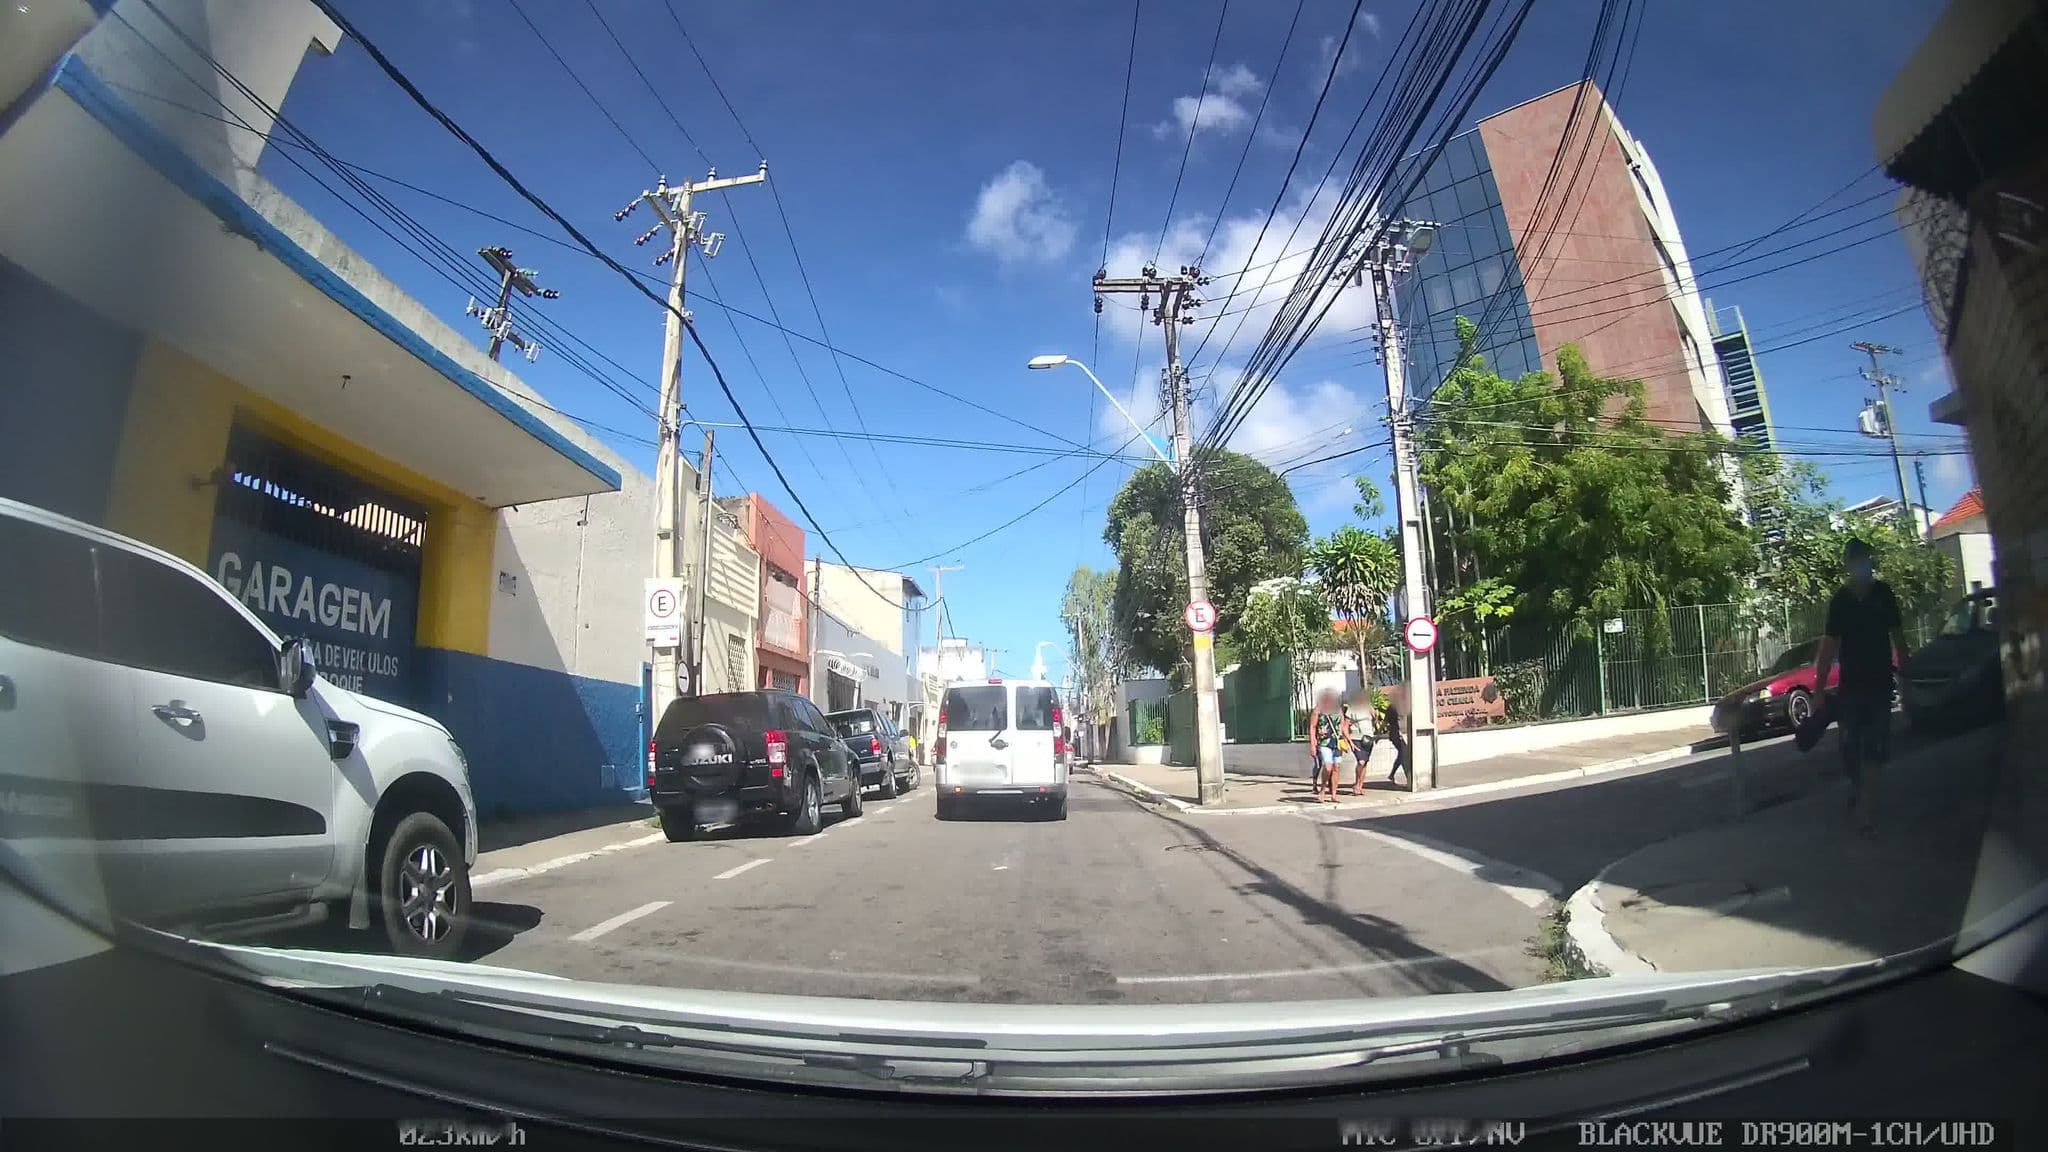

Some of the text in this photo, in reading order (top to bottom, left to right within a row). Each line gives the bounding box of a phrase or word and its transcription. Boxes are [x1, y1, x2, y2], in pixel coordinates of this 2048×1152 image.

[217, 551, 392, 639] GARAGEM
[658, 596, 667, 612] E
[1195, 607, 1206, 623] E
[325, 643, 341, 667] DE
